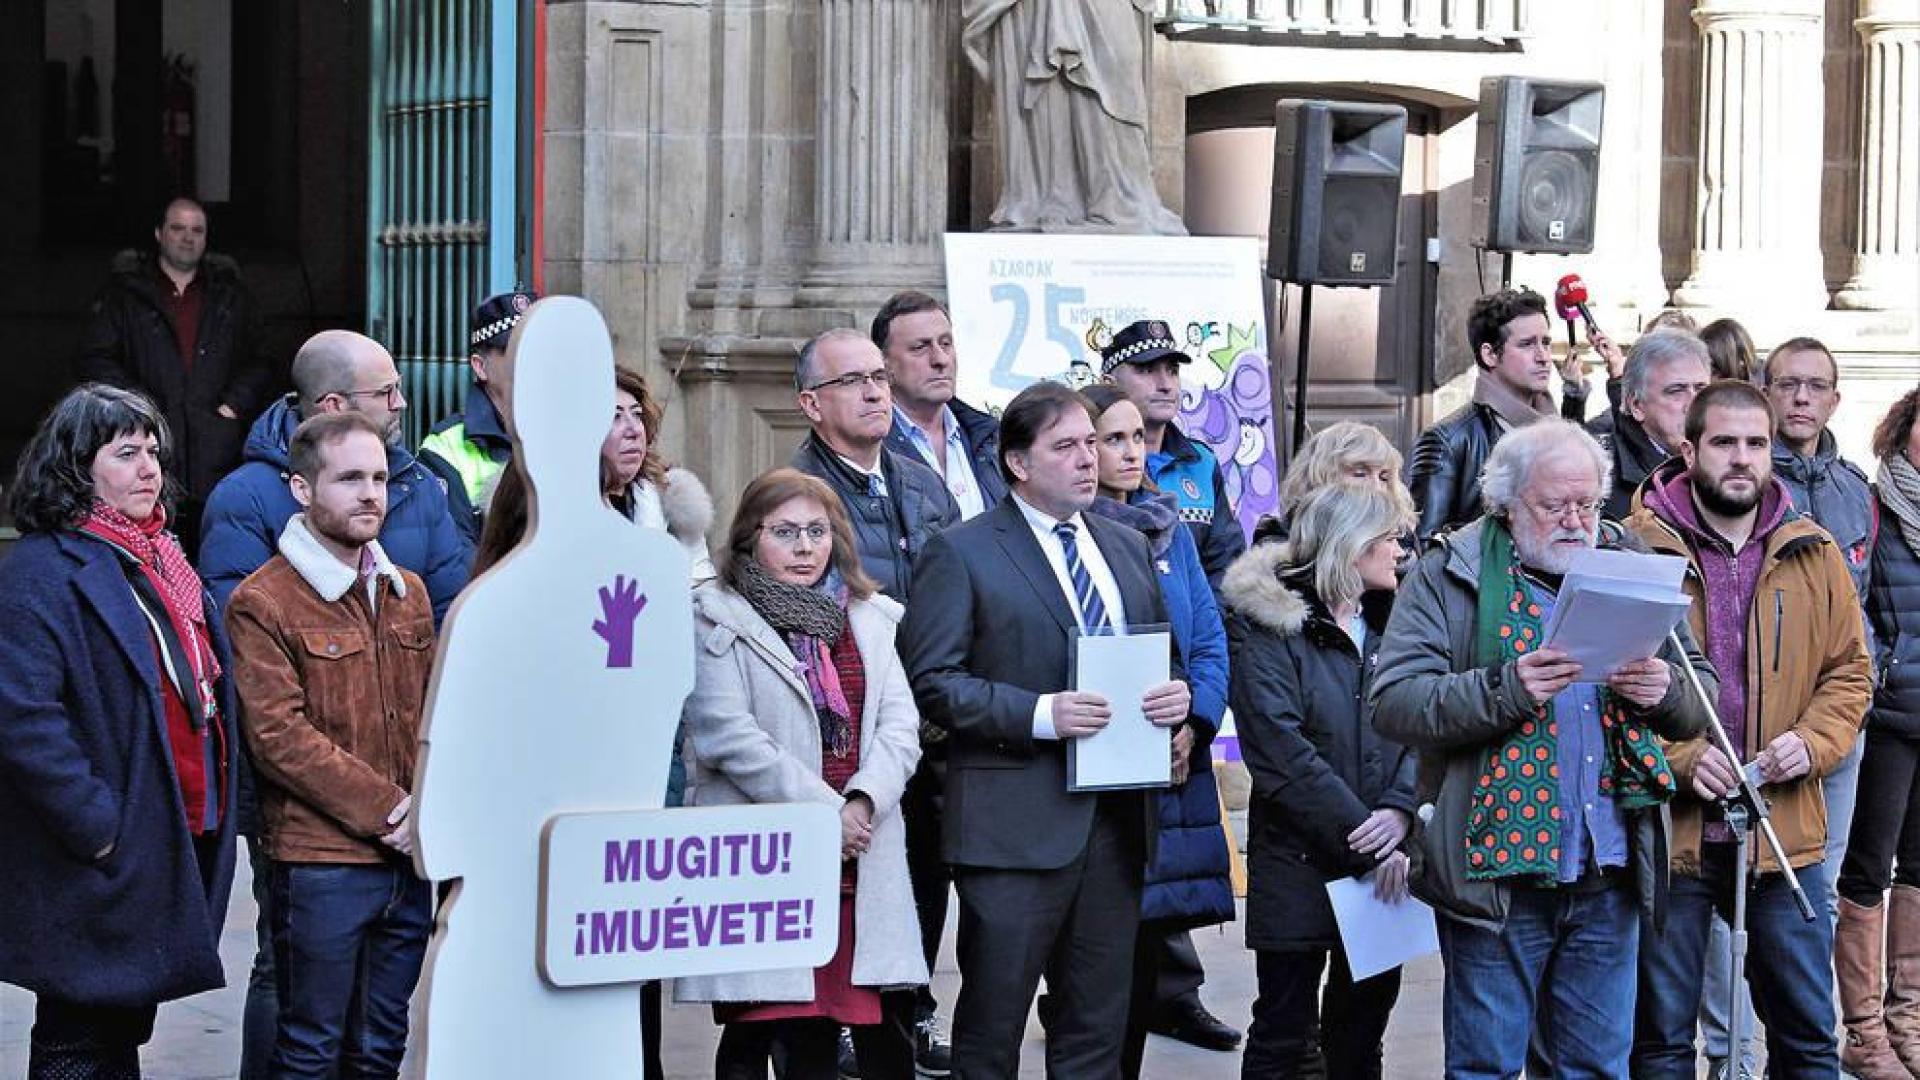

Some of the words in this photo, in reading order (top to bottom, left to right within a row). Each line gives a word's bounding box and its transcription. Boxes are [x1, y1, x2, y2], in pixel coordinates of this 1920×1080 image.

[989, 283, 1086, 391] 25
[604, 832, 792, 883] MUGITU!
[575, 897, 814, 957] ¡MUÉVETE!
